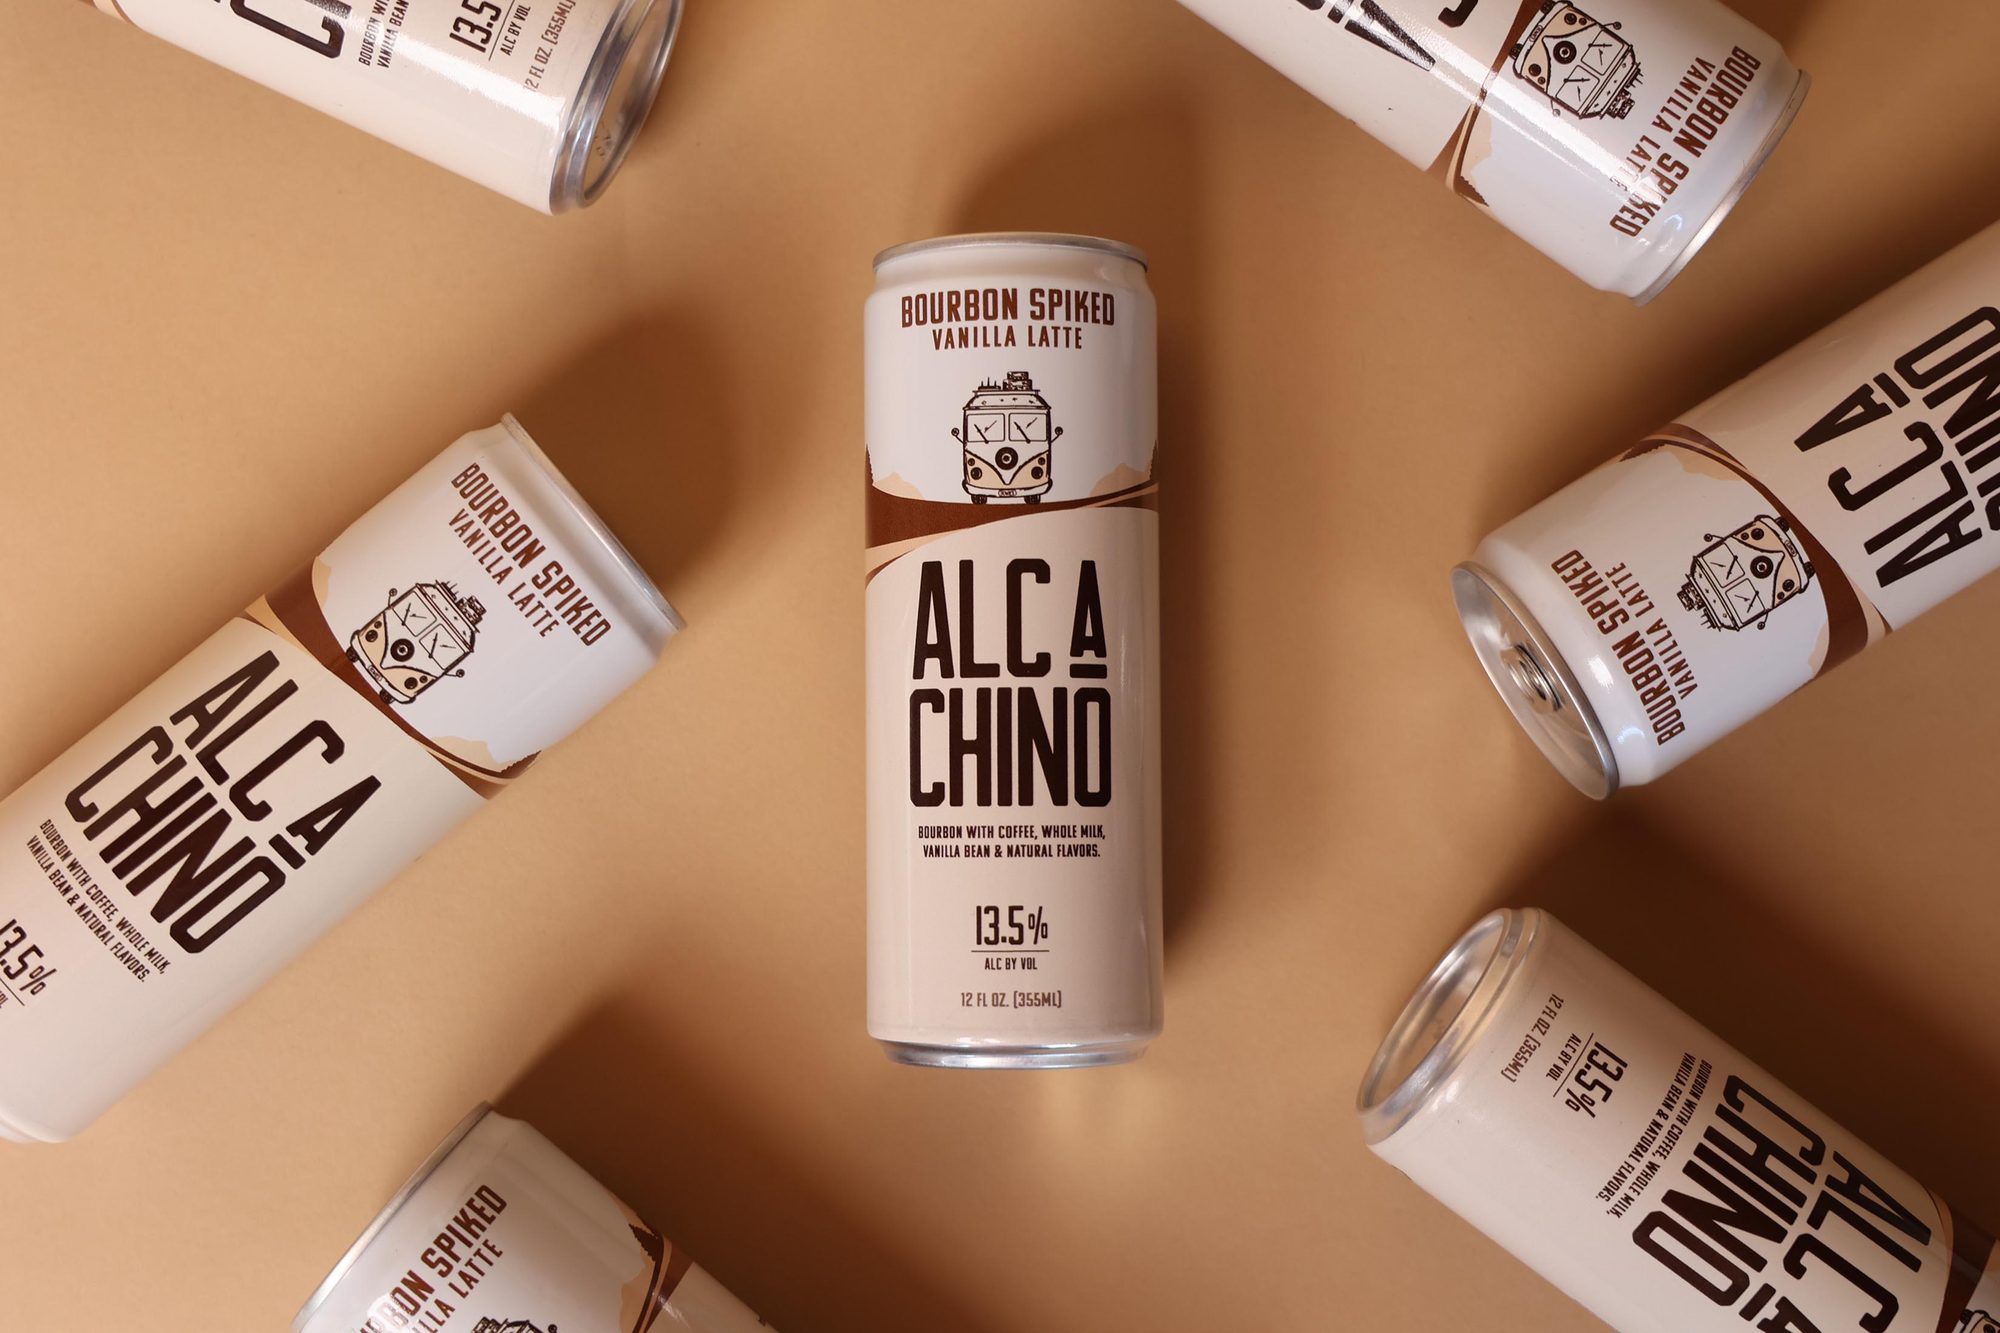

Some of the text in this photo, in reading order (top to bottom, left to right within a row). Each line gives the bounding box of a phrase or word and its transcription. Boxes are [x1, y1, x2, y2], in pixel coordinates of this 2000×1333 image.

[358, 0, 390, 66] BOURBON WI
[377, 0, 409, 68] VANILLA BEAN
[500, 5, 531, 56] ALC BY VOL
[534, 47, 553, 65] OZ.
[528, 65, 544, 79] FL
[1652, 57, 1716, 133] VANILLA
[1672, 46, 1761, 158] BOURBON
[901, 288, 1115, 328] BOURBON SPIKED
[932, 325, 1083, 350] VANILLA LATTE
[1793, 372, 1983, 588] ALCA
[449, 508, 560, 638] VANILLA LATTE
[451, 462, 612, 647] BOURBON SPIKED
[912, 558, 1107, 679] ALCA
[1551, 549, 1686, 746] BOURBON SPIKED
[1605, 562, 1698, 700] VANILLA LATTE
[169, 649, 382, 870] ALCA
[909, 686, 1111, 807] CHINO
[64, 725, 286, 954] CHINO
[918, 824, 1106, 840] BOURBON WITH COFFEE, WHOLE MILK,
[923, 844, 1101, 858] VANILLA BEAN & NATURAL FLAVORS.
[26, 835, 150, 983] VANILLA BEAN & NATURAL FLAVORS.
[40, 819, 171, 975] BOURBON WITH COFFEE, WHOLE MILK,
[976, 905, 1048, 945] 13.5%
[961, 992, 973, 1007] 12
[977, 992, 988, 1007] FL
[992, 992, 1009, 1007] OZ.
[984, 957, 1038, 970] ALC BY VOL
[1531, 1017, 1551, 1036] OZ.
[1542, 1005, 1557, 1020] FL
[1551, 994, 1564, 1010] 12
[1545, 1033, 1582, 1082] ALC BY VOL
[1564, 1041, 1628, 1118] 13.5%
[1595, 1052, 1696, 1202] VANILLA BEAN & NATURAL FLAVORS.
[1606, 1059, 1713, 1219] BOURBON WITH COFFEE, WHOLE MILK,
[1632, 1075, 1826, 1307] CHINO
[420, 1184, 508, 1278] SPIKED
[448, 1238, 503, 1298] LATTE
